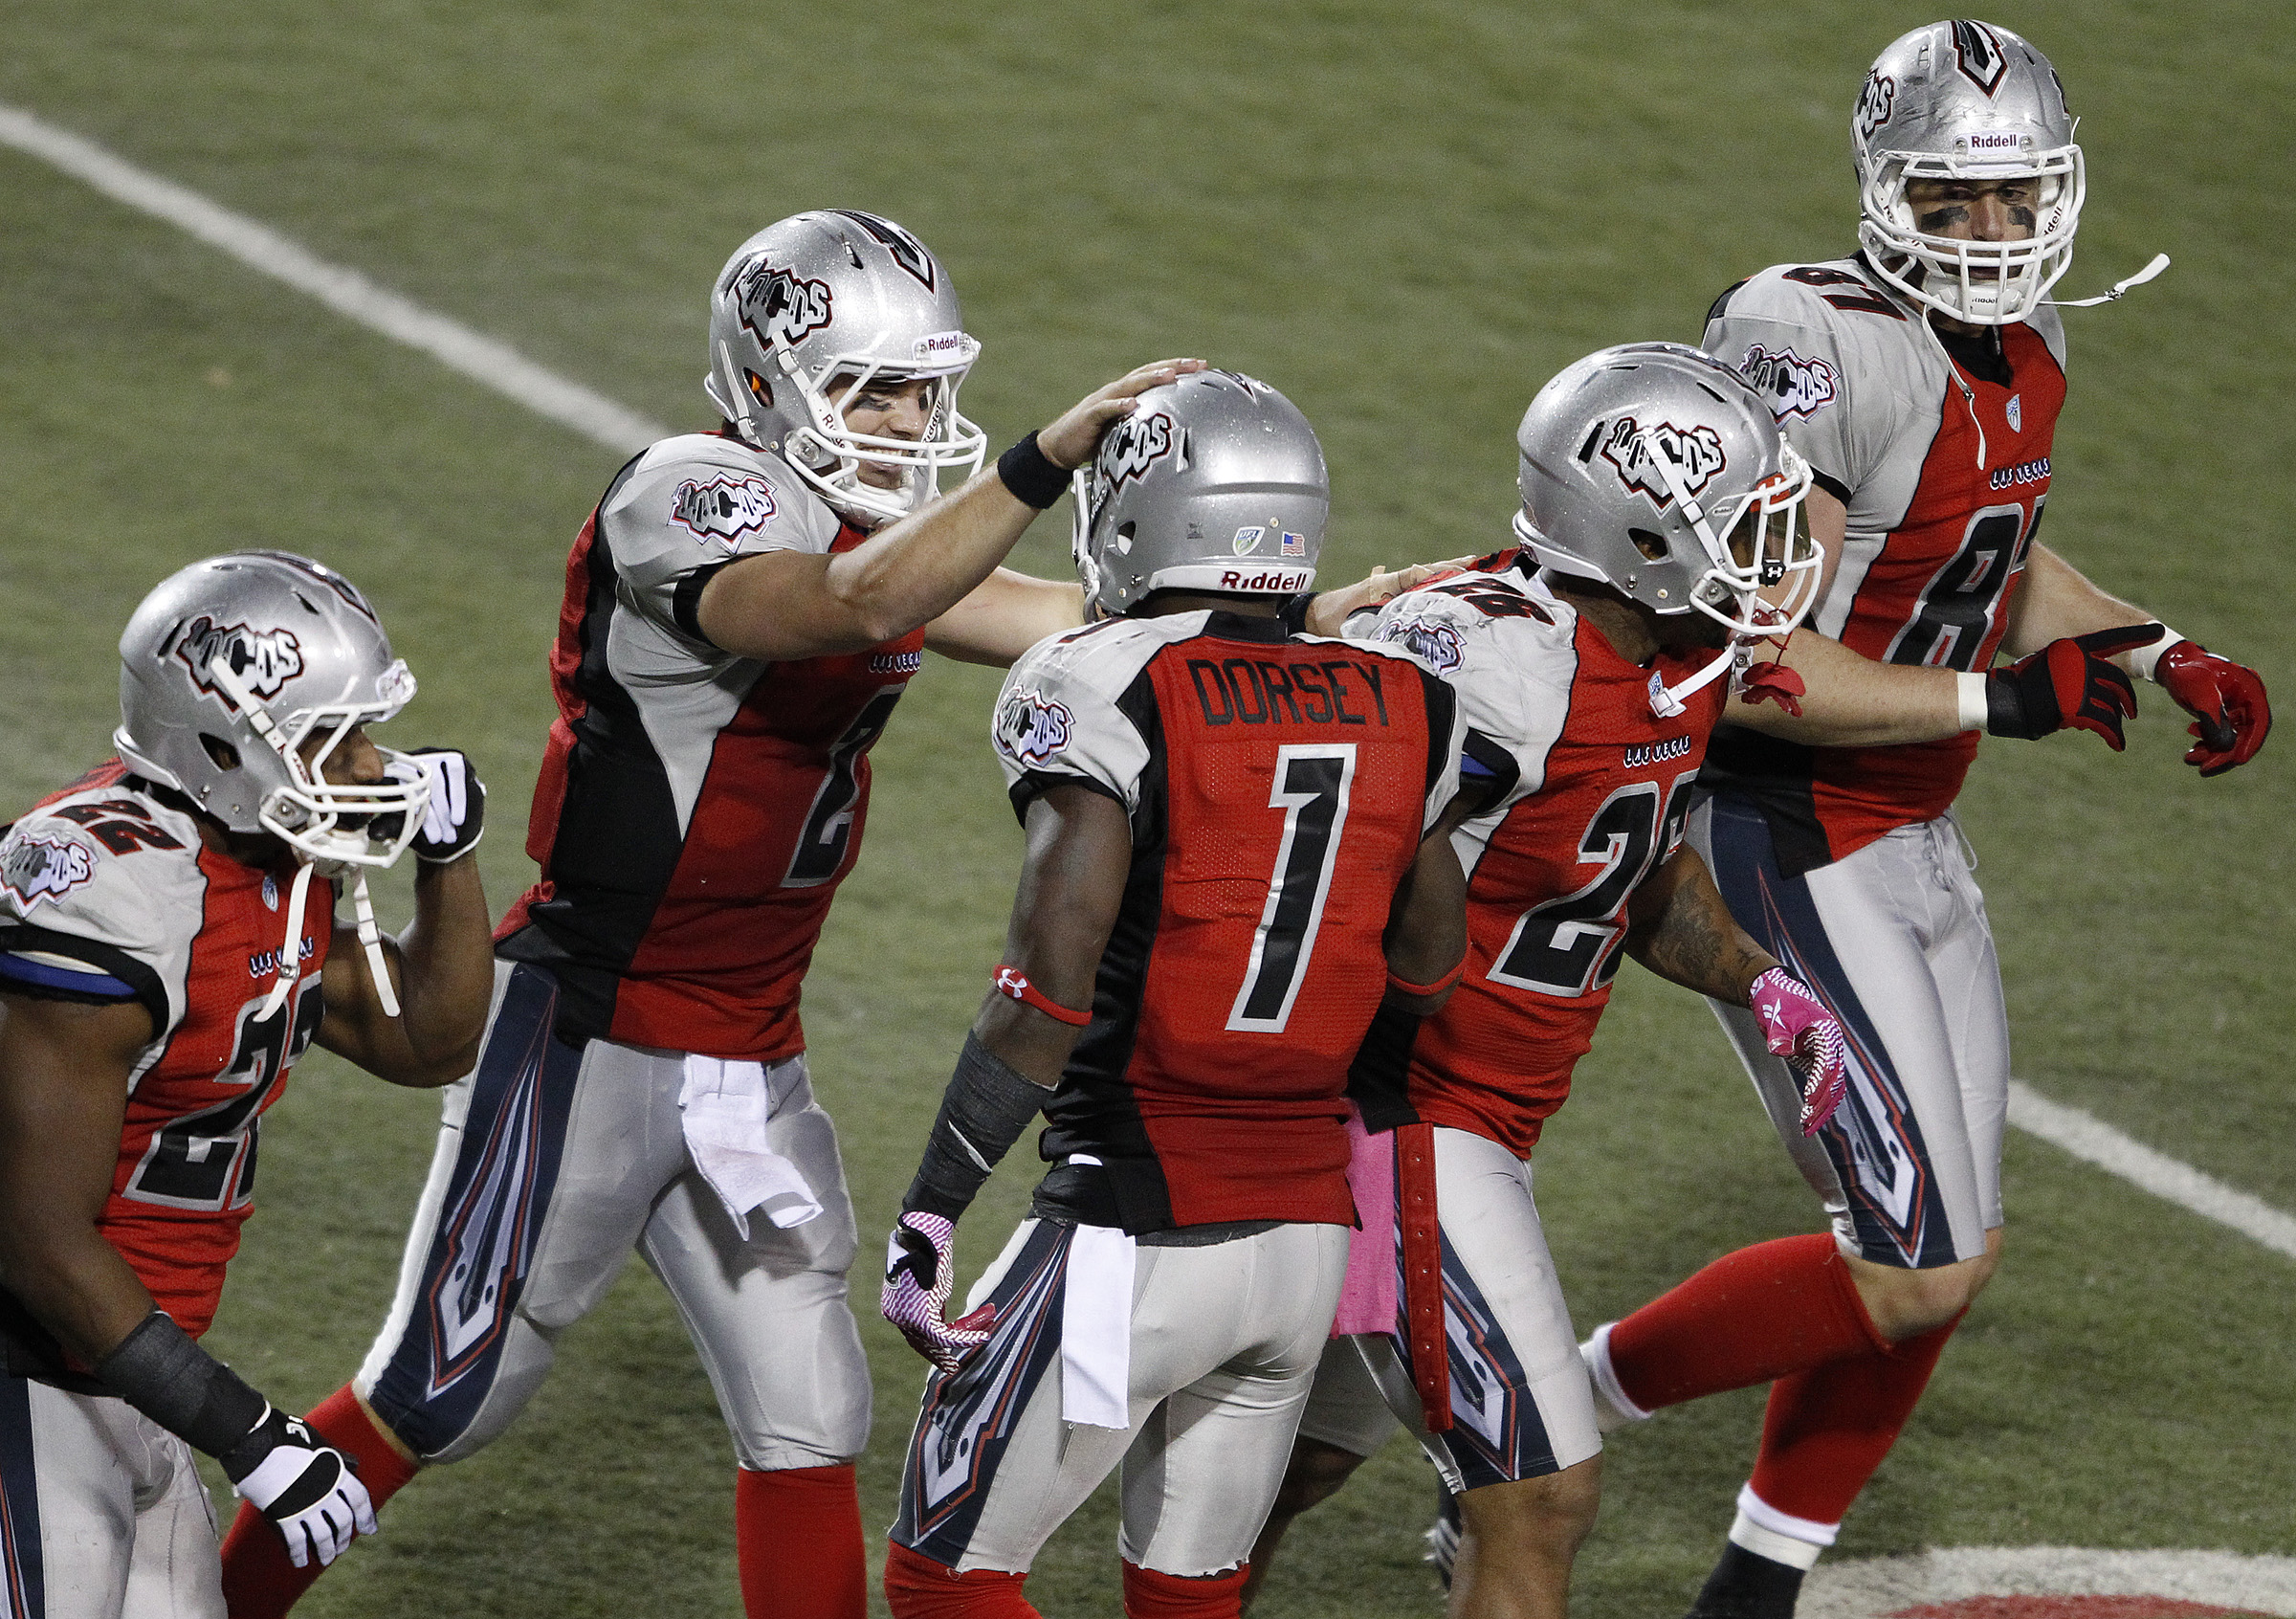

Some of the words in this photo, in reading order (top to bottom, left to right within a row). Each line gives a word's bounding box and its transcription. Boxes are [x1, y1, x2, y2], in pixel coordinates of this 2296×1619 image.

[1971, 134, 2017, 149] Riddell
[928, 335, 958, 351] Riddell
[1989, 467, 2014, 490] LAS
[2016, 456, 2051, 484] VEGAS
[672, 477, 778, 543] LOCOS
[1240, 529, 1258, 538] UFL
[1221, 570, 1308, 590] Riddell
[1186, 658, 1389, 726] DORSEY
[1623, 745, 1651, 768] LAS
[1652, 735, 1691, 763] VEGAS
[1225, 743, 1358, 1033] 1
